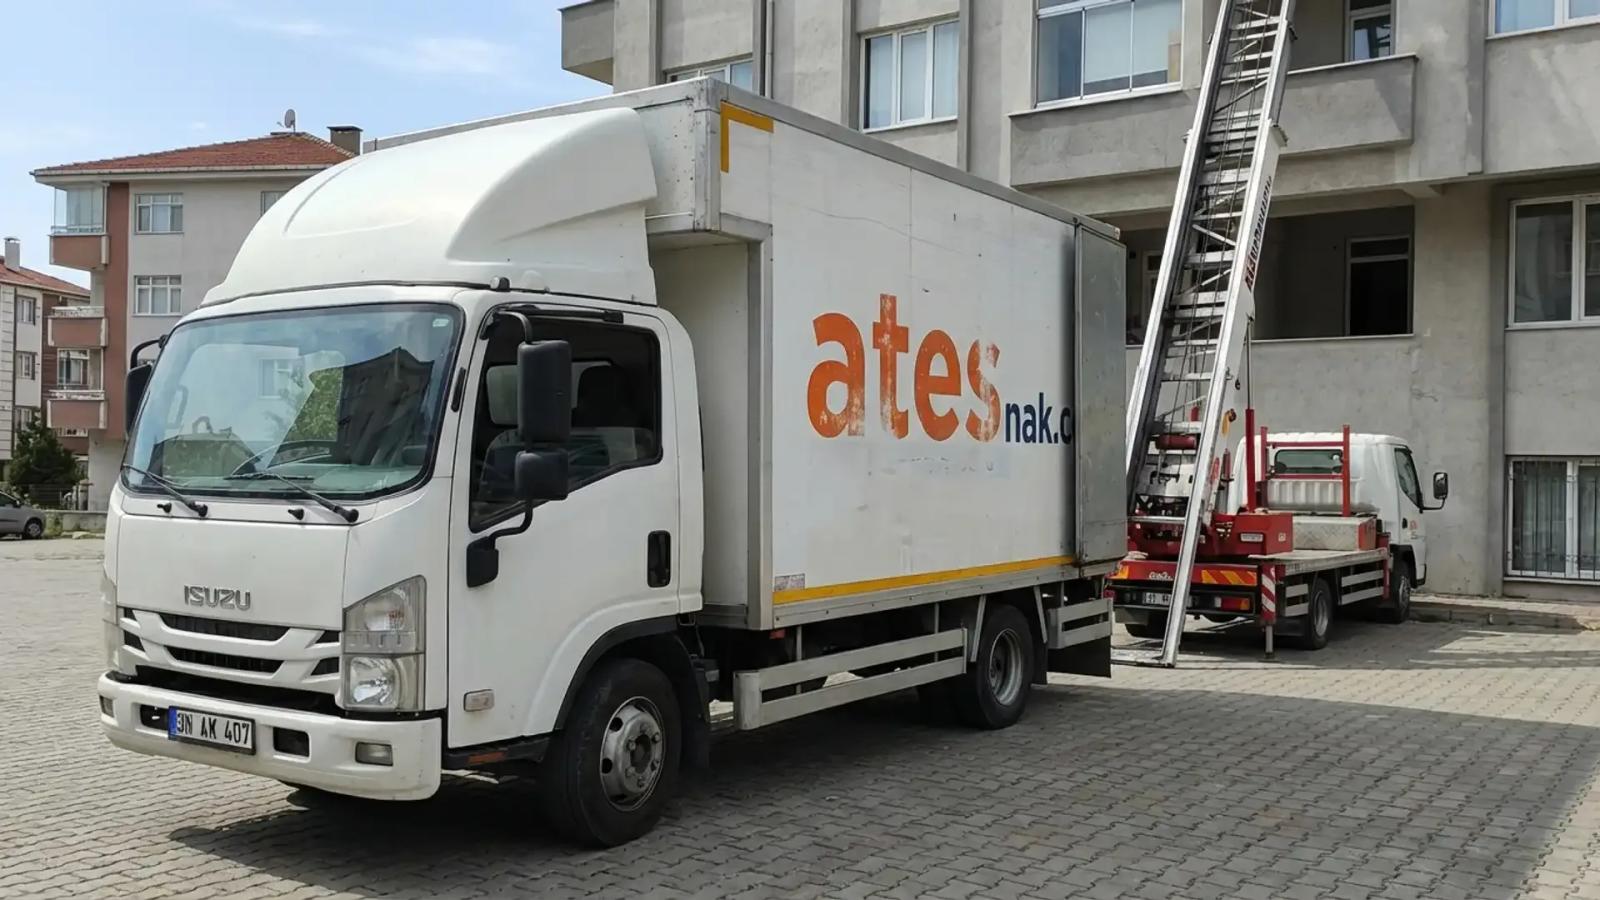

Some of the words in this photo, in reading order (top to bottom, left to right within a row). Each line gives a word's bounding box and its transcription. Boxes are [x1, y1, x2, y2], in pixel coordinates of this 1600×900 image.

[184, 585, 251, 611] ISUZU
[201, 716, 217, 740] AK
[224, 719, 250, 745] 407
